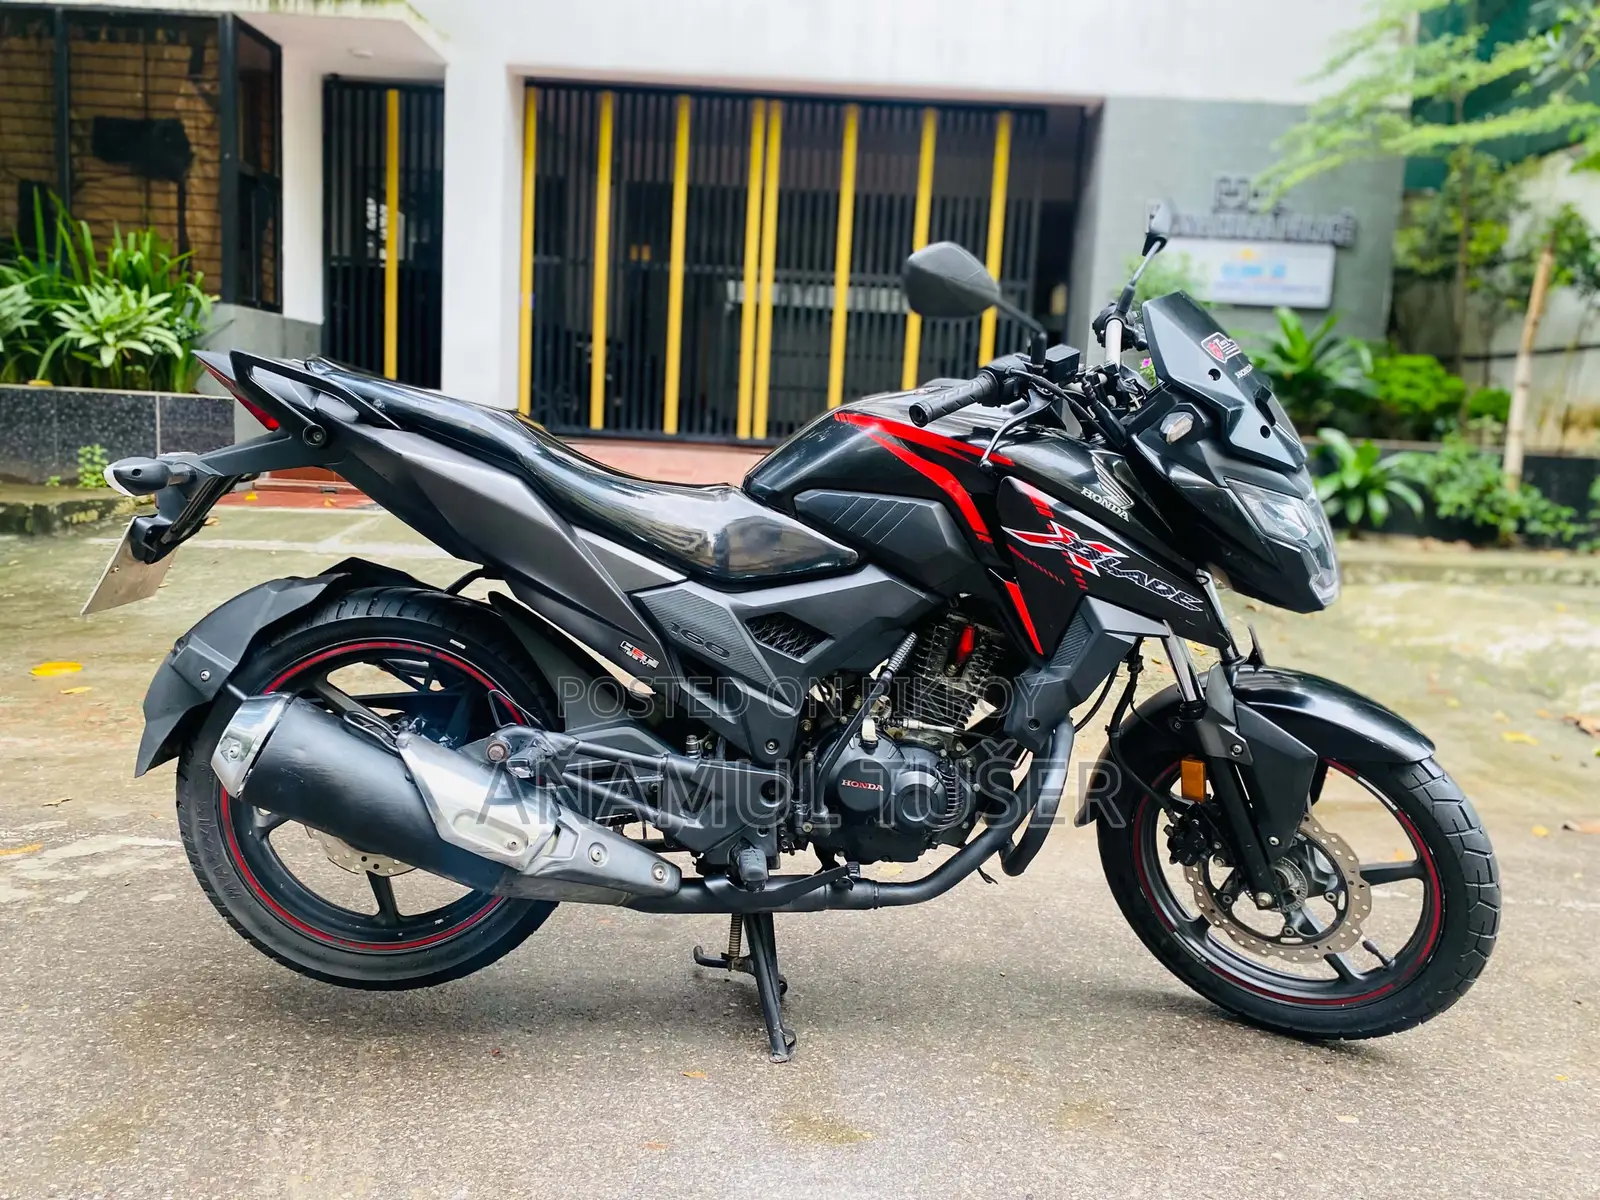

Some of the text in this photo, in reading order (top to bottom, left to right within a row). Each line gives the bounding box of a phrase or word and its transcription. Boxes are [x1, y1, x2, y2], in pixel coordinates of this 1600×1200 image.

[1080, 486, 1130, 522] HONDA
[669, 621, 730, 660] 160
[840, 779, 885, 792] HONDA
